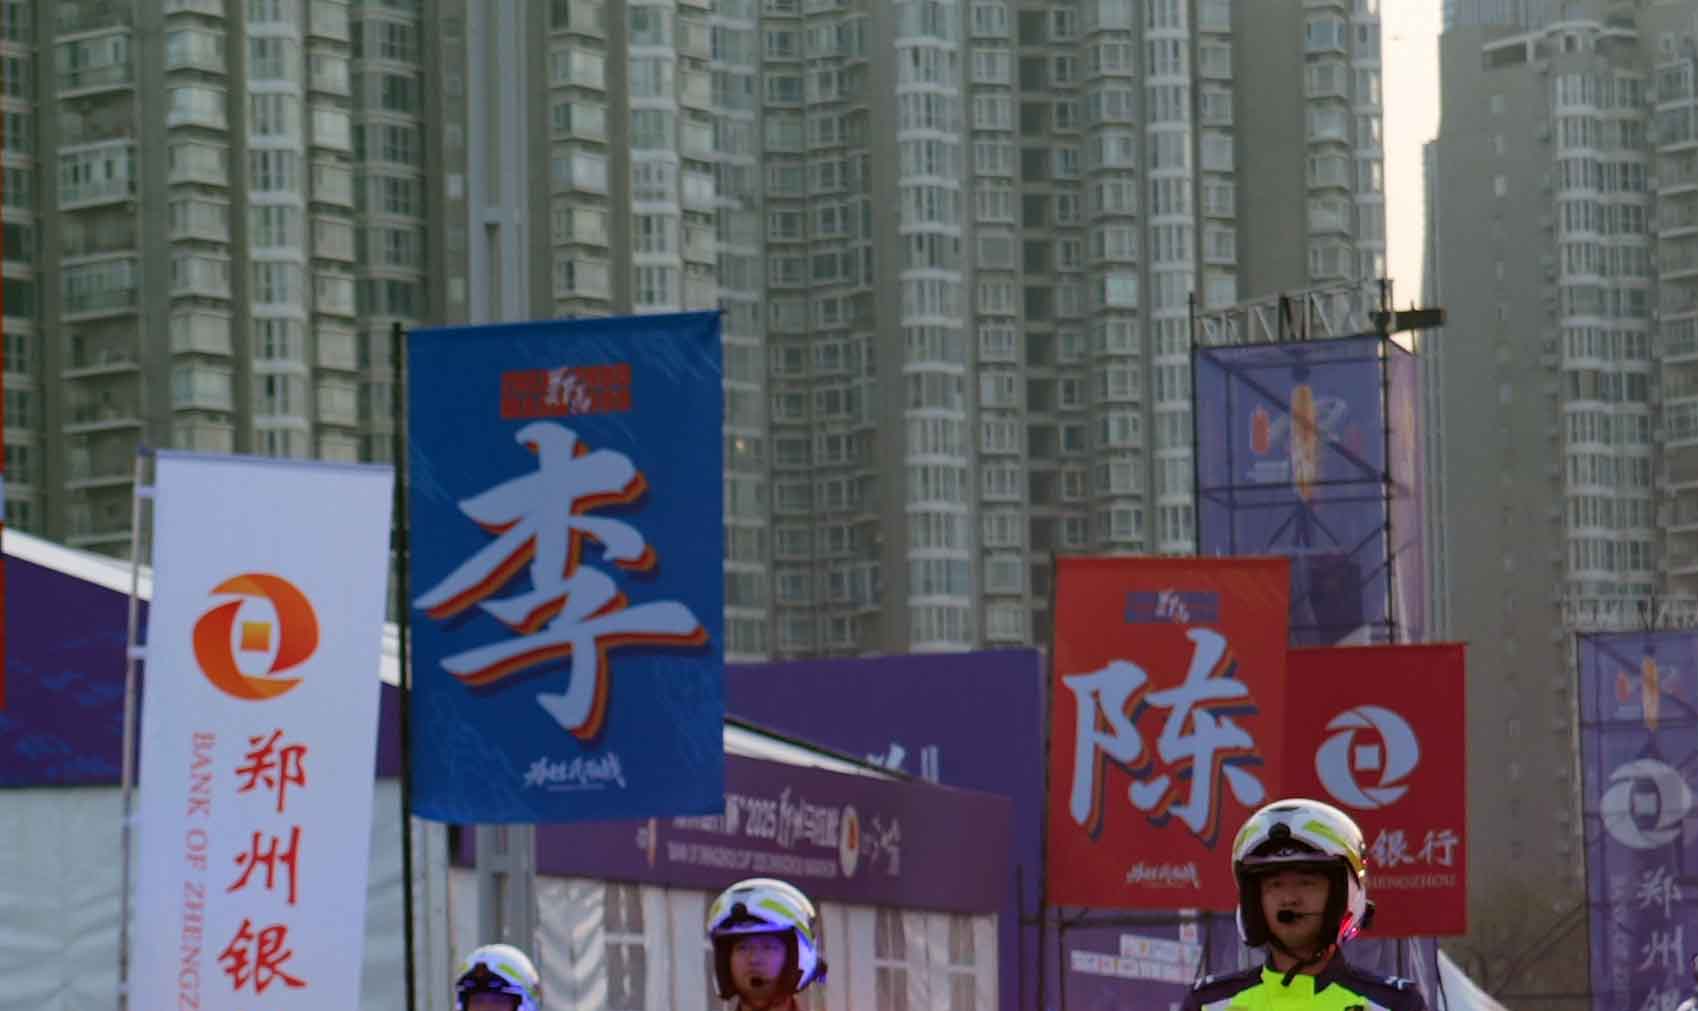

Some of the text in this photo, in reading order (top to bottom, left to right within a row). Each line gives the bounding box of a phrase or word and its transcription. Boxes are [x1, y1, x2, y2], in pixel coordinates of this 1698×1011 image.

[413, 421, 708, 738] 李
[187, 731, 217, 817] BANK
[1062, 627, 1268, 845] 陈
[184, 829, 209, 870] OF
[1370, 829, 1459, 868] 银行
